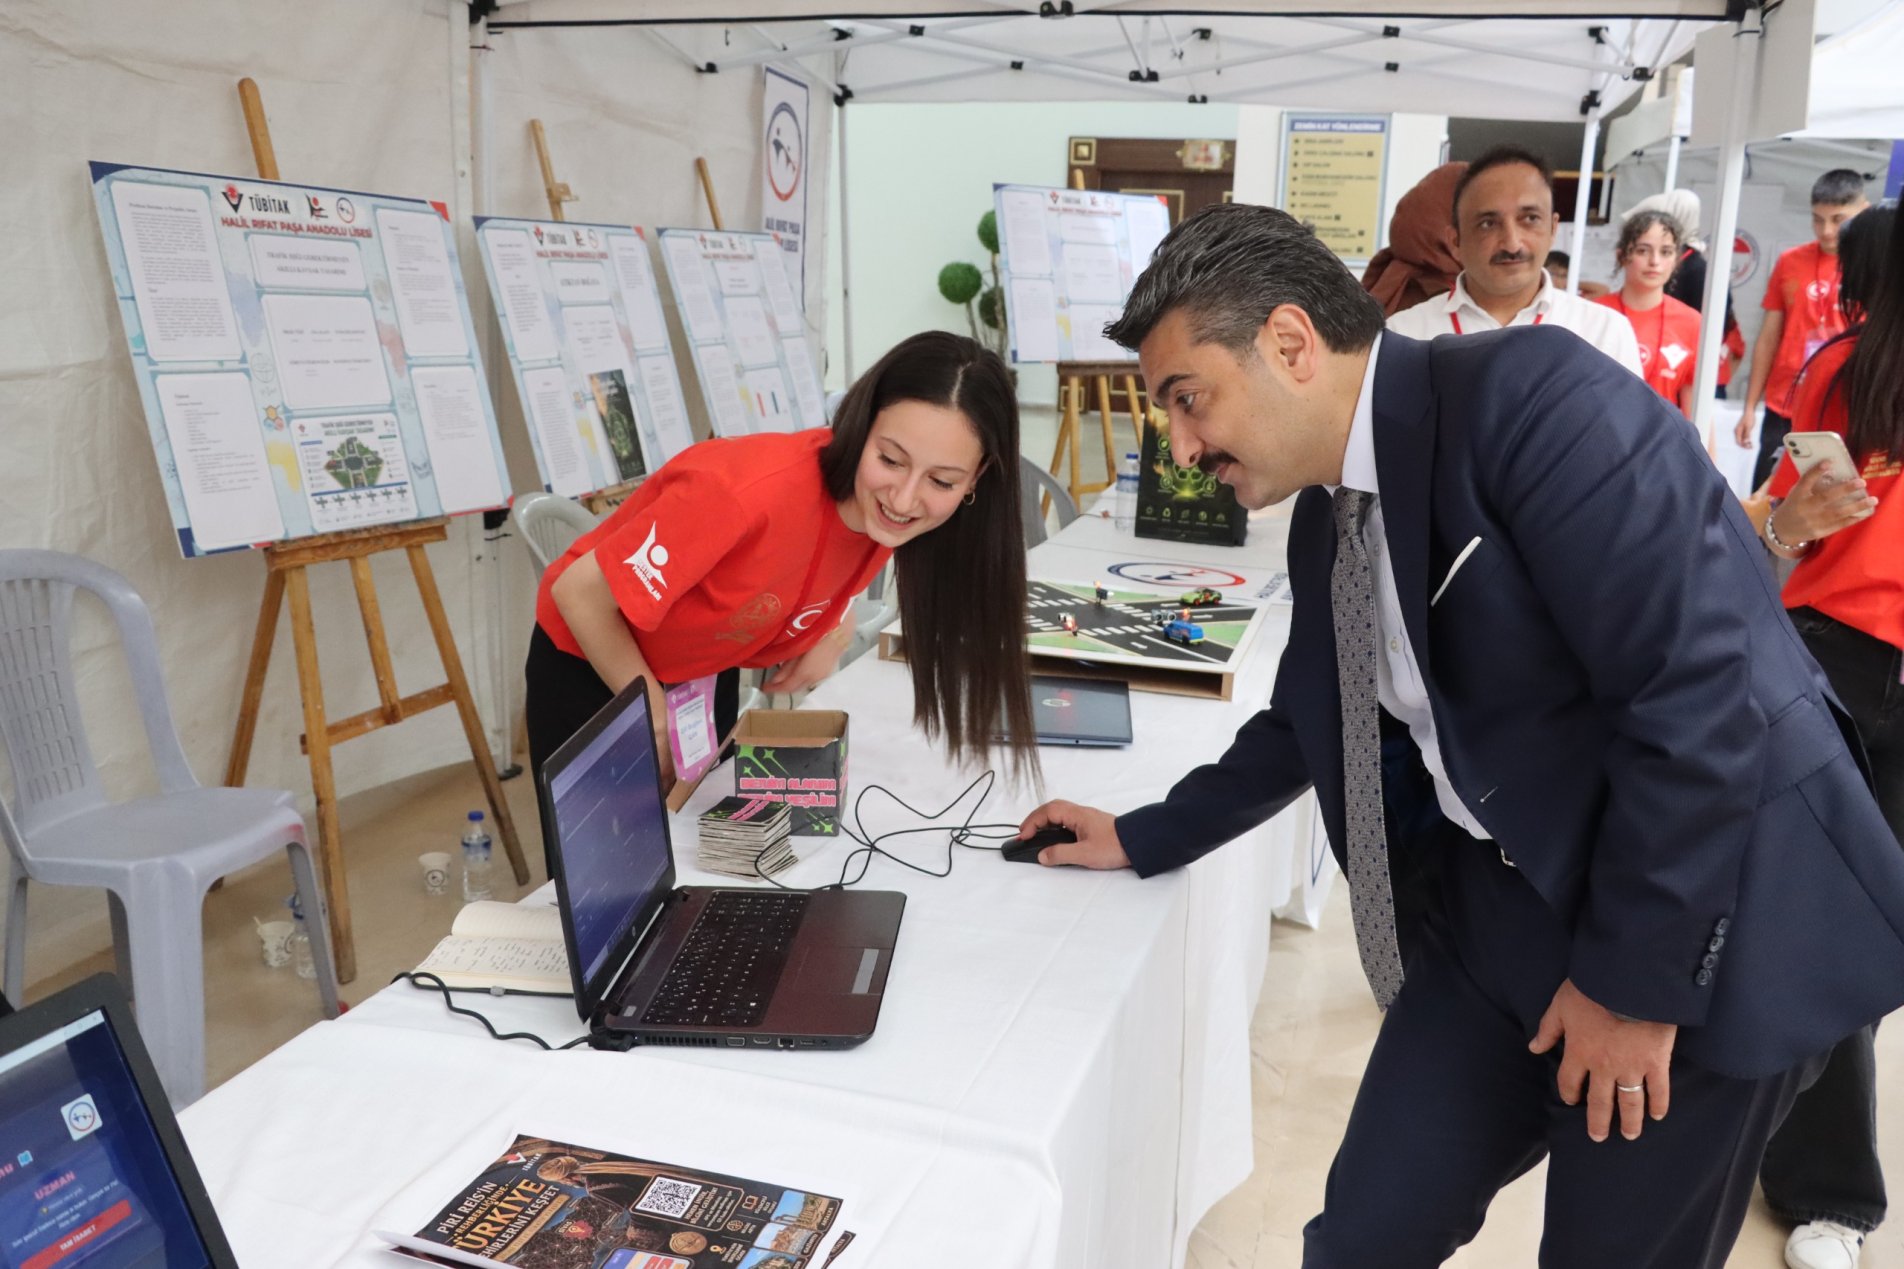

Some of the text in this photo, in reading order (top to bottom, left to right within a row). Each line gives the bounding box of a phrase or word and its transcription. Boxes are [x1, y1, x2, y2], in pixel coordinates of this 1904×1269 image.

[221, 215, 250, 229] HALİL
[280, 222, 304, 235] PAŞA
[306, 224, 348, 236] ANADOLU
[248, 194, 291, 214] TÜBİTAK
[34, 1170, 76, 1200] UZMAN
[437, 1181, 498, 1234] PİRİ REİS'İN
[455, 1185, 508, 1234] REHBERLİĞİNDE
[452, 1178, 546, 1249] ÜRKİYE
[480, 1185, 560, 1258] EHİRLERİNİ KEŞFET
